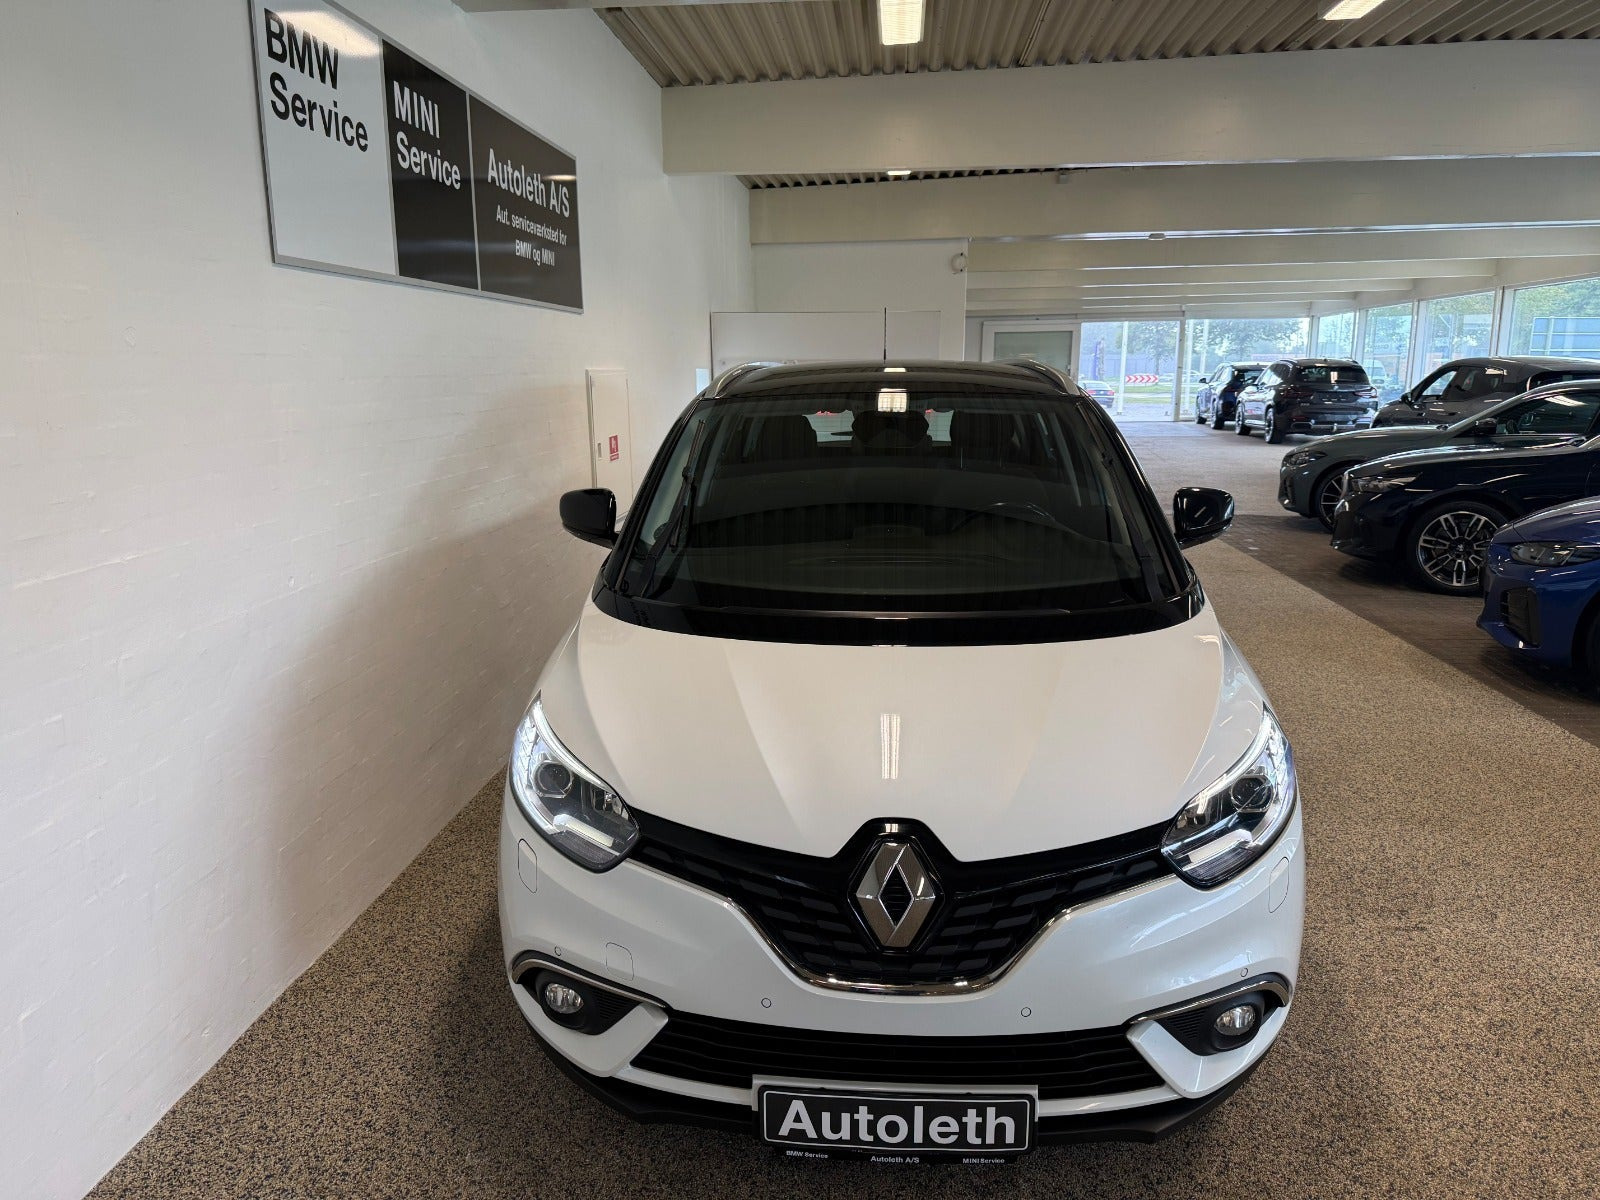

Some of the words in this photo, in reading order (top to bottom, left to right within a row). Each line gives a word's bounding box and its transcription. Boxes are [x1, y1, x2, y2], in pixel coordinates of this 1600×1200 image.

[264, 8, 339, 90] BMW
[269, 71, 369, 152] Service
[393, 80, 440, 139] MINI
[396, 131, 461, 190] Service
[487, 147, 547, 208] Autoleth
[549, 180, 570, 218] A/S
[496, 204, 510, 226] Aut.
[515, 239, 532, 260] BMW
[532, 248, 541, 266] og
[541, 247, 555, 266] MINI
[777, 1099, 1016, 1145] Autoleth
[786, 1150, 803, 1158] BMW
[870, 1155, 904, 1164] Autoleth
[904, 1156, 920, 1164] A/S
